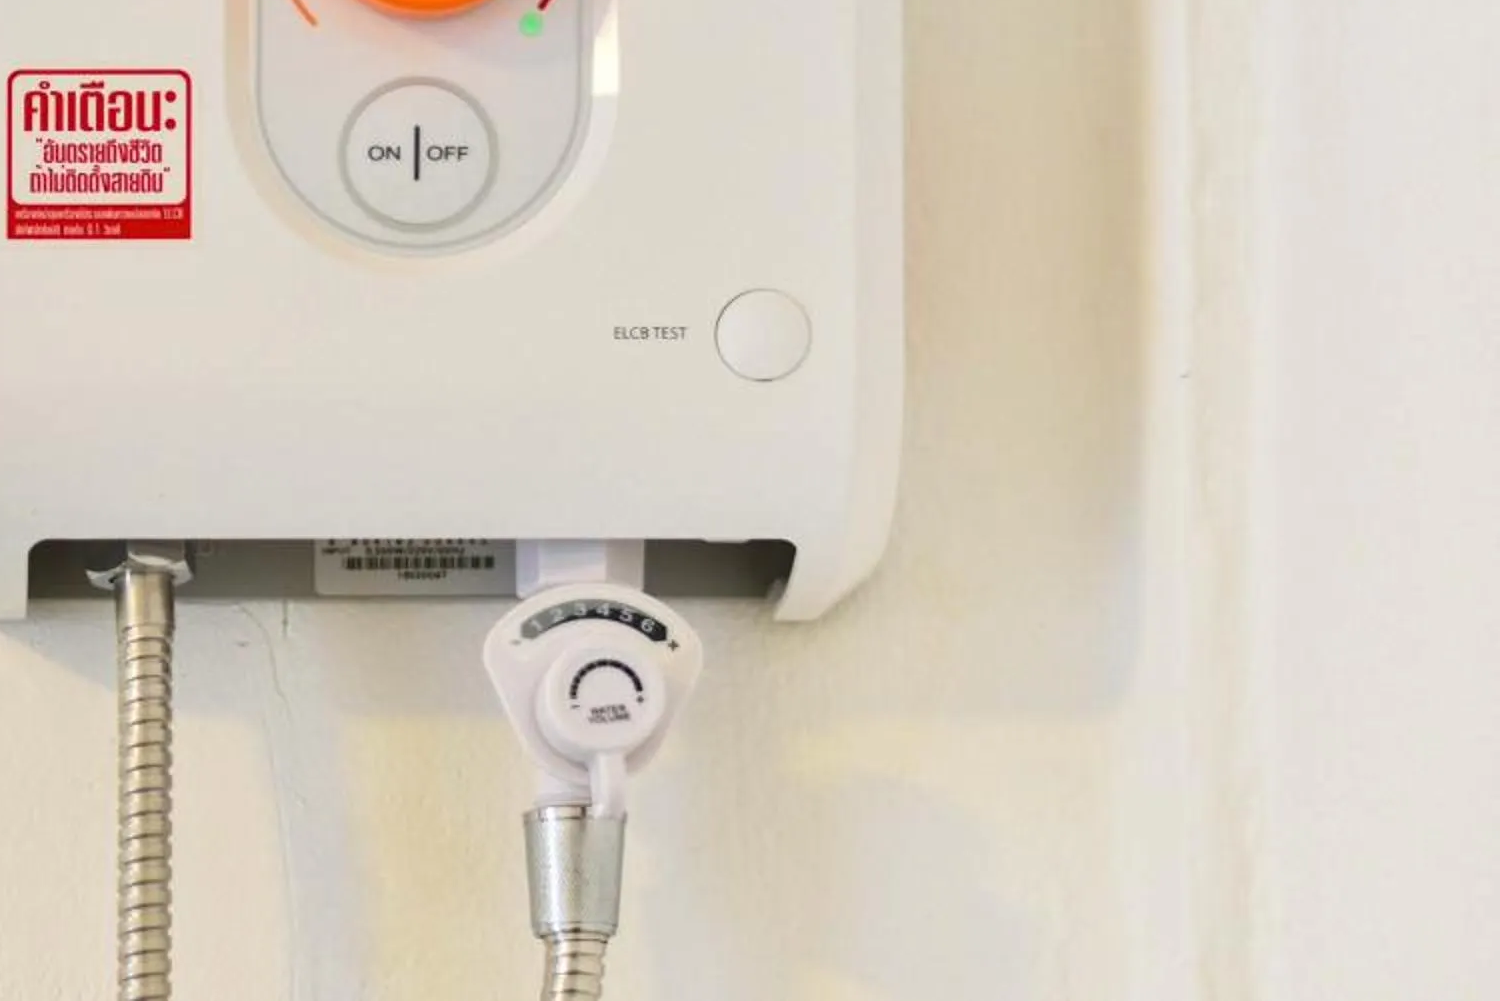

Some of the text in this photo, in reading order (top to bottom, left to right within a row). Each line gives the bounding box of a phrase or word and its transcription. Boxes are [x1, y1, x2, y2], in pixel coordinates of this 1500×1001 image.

[23, 80, 178, 132] คำเตือน:
[368, 145, 469, 162] ON OFF
[613, 326, 687, 340] ELCB TEST
[551, 608, 565, 621] 2
[574, 602, 588, 616] 3
[596, 602, 610, 617] 4
[619, 608, 633, 623] 5
[640, 618, 655, 632] 6
